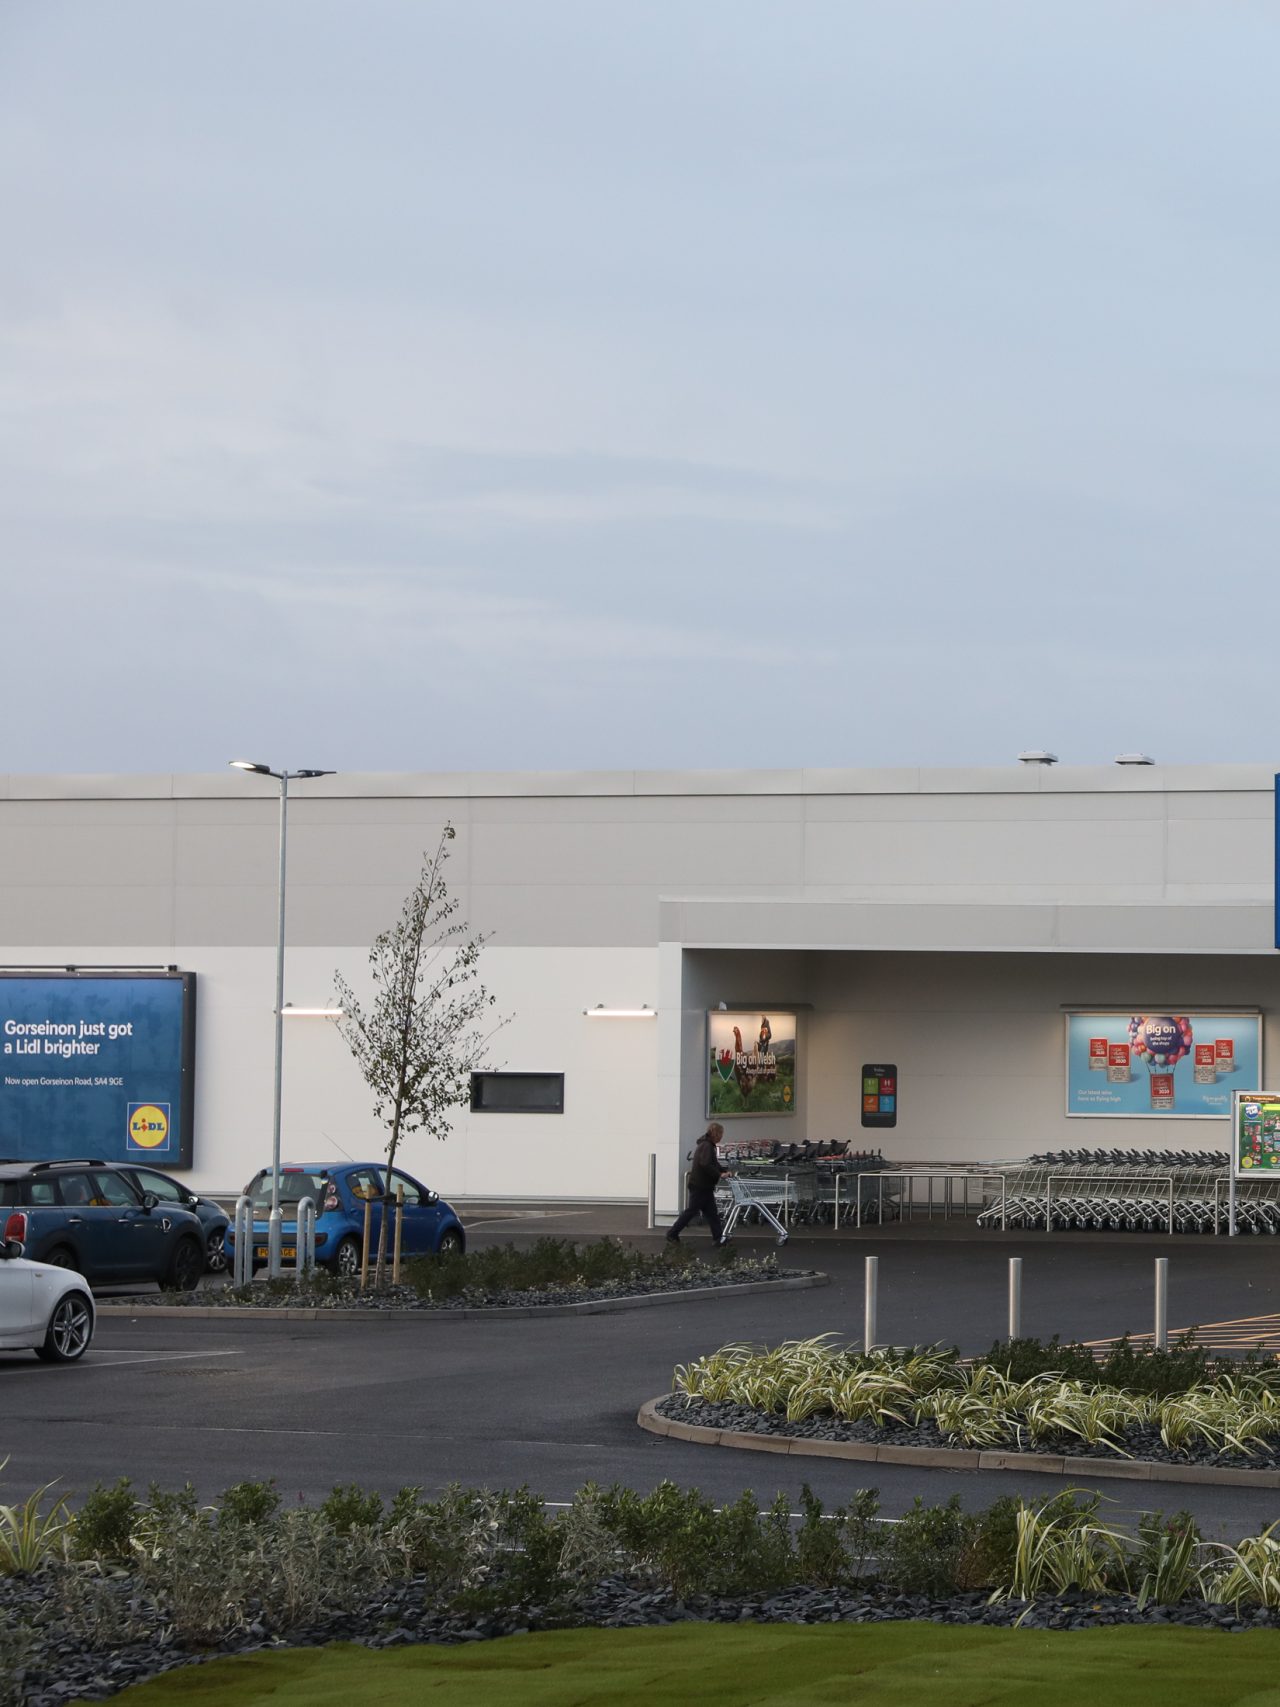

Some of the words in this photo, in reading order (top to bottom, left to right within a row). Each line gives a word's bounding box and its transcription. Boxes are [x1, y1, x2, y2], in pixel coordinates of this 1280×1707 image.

[4, 1020, 77, 1036] Gorseinon
[78, 1020, 106, 1040] just
[108, 1022, 133, 1040] got
[1146, 1024, 1162, 1036] Big
[1162, 1025, 1176, 1034] on
[4, 1042, 13, 1054] a
[16, 1039, 41, 1055] Lidl
[44, 1039, 100, 1059] brighter
[737, 1052, 747, 1069] Big
[757, 1052, 776, 1065] Welsh
[4, 1077, 21, 1085] Now
[21, 1079, 39, 1087] open
[39, 1077, 74, 1086] Gorseinon
[74, 1077, 93, 1087] Road,
